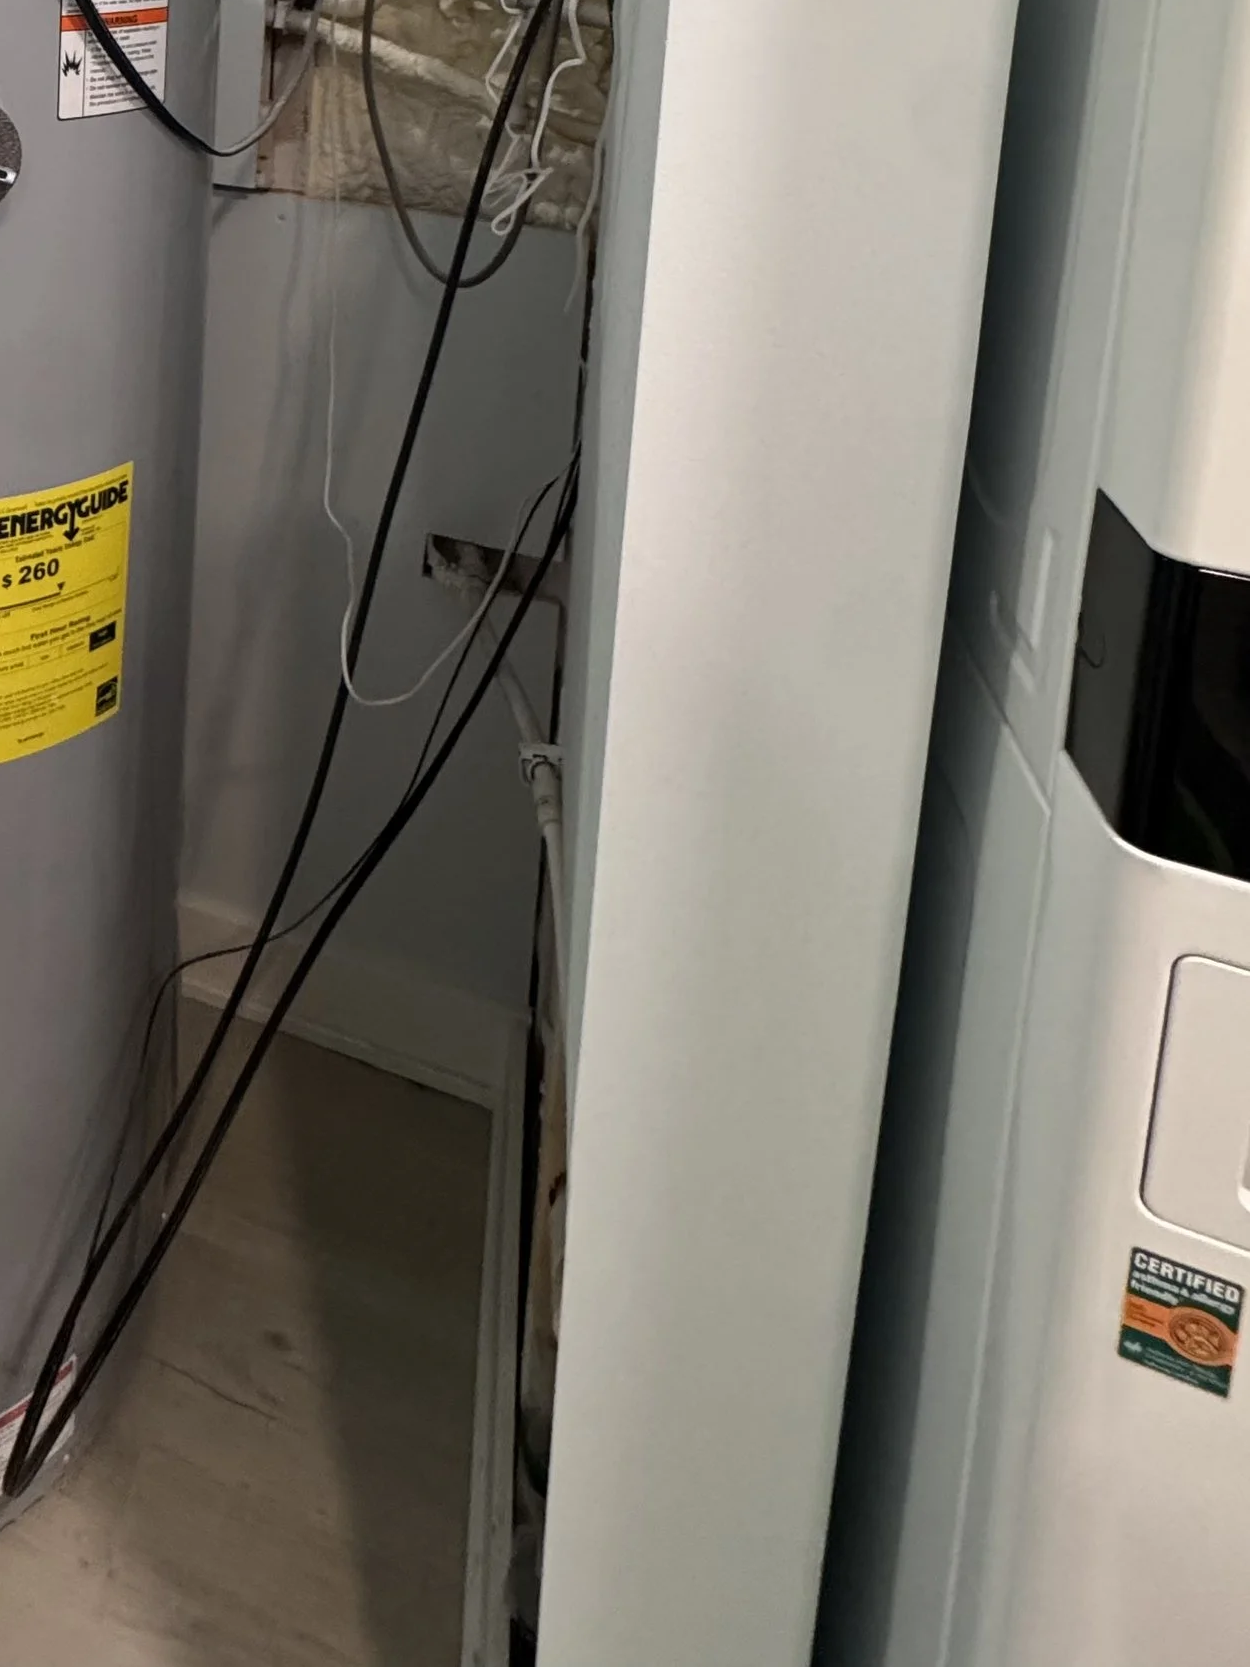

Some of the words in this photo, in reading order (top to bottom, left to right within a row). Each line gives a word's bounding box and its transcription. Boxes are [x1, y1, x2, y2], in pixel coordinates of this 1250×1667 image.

[2, 574, 12, 590] $
[18, 558, 59, 585] 260
[1134, 1252, 1240, 1303] CERTIFIED
